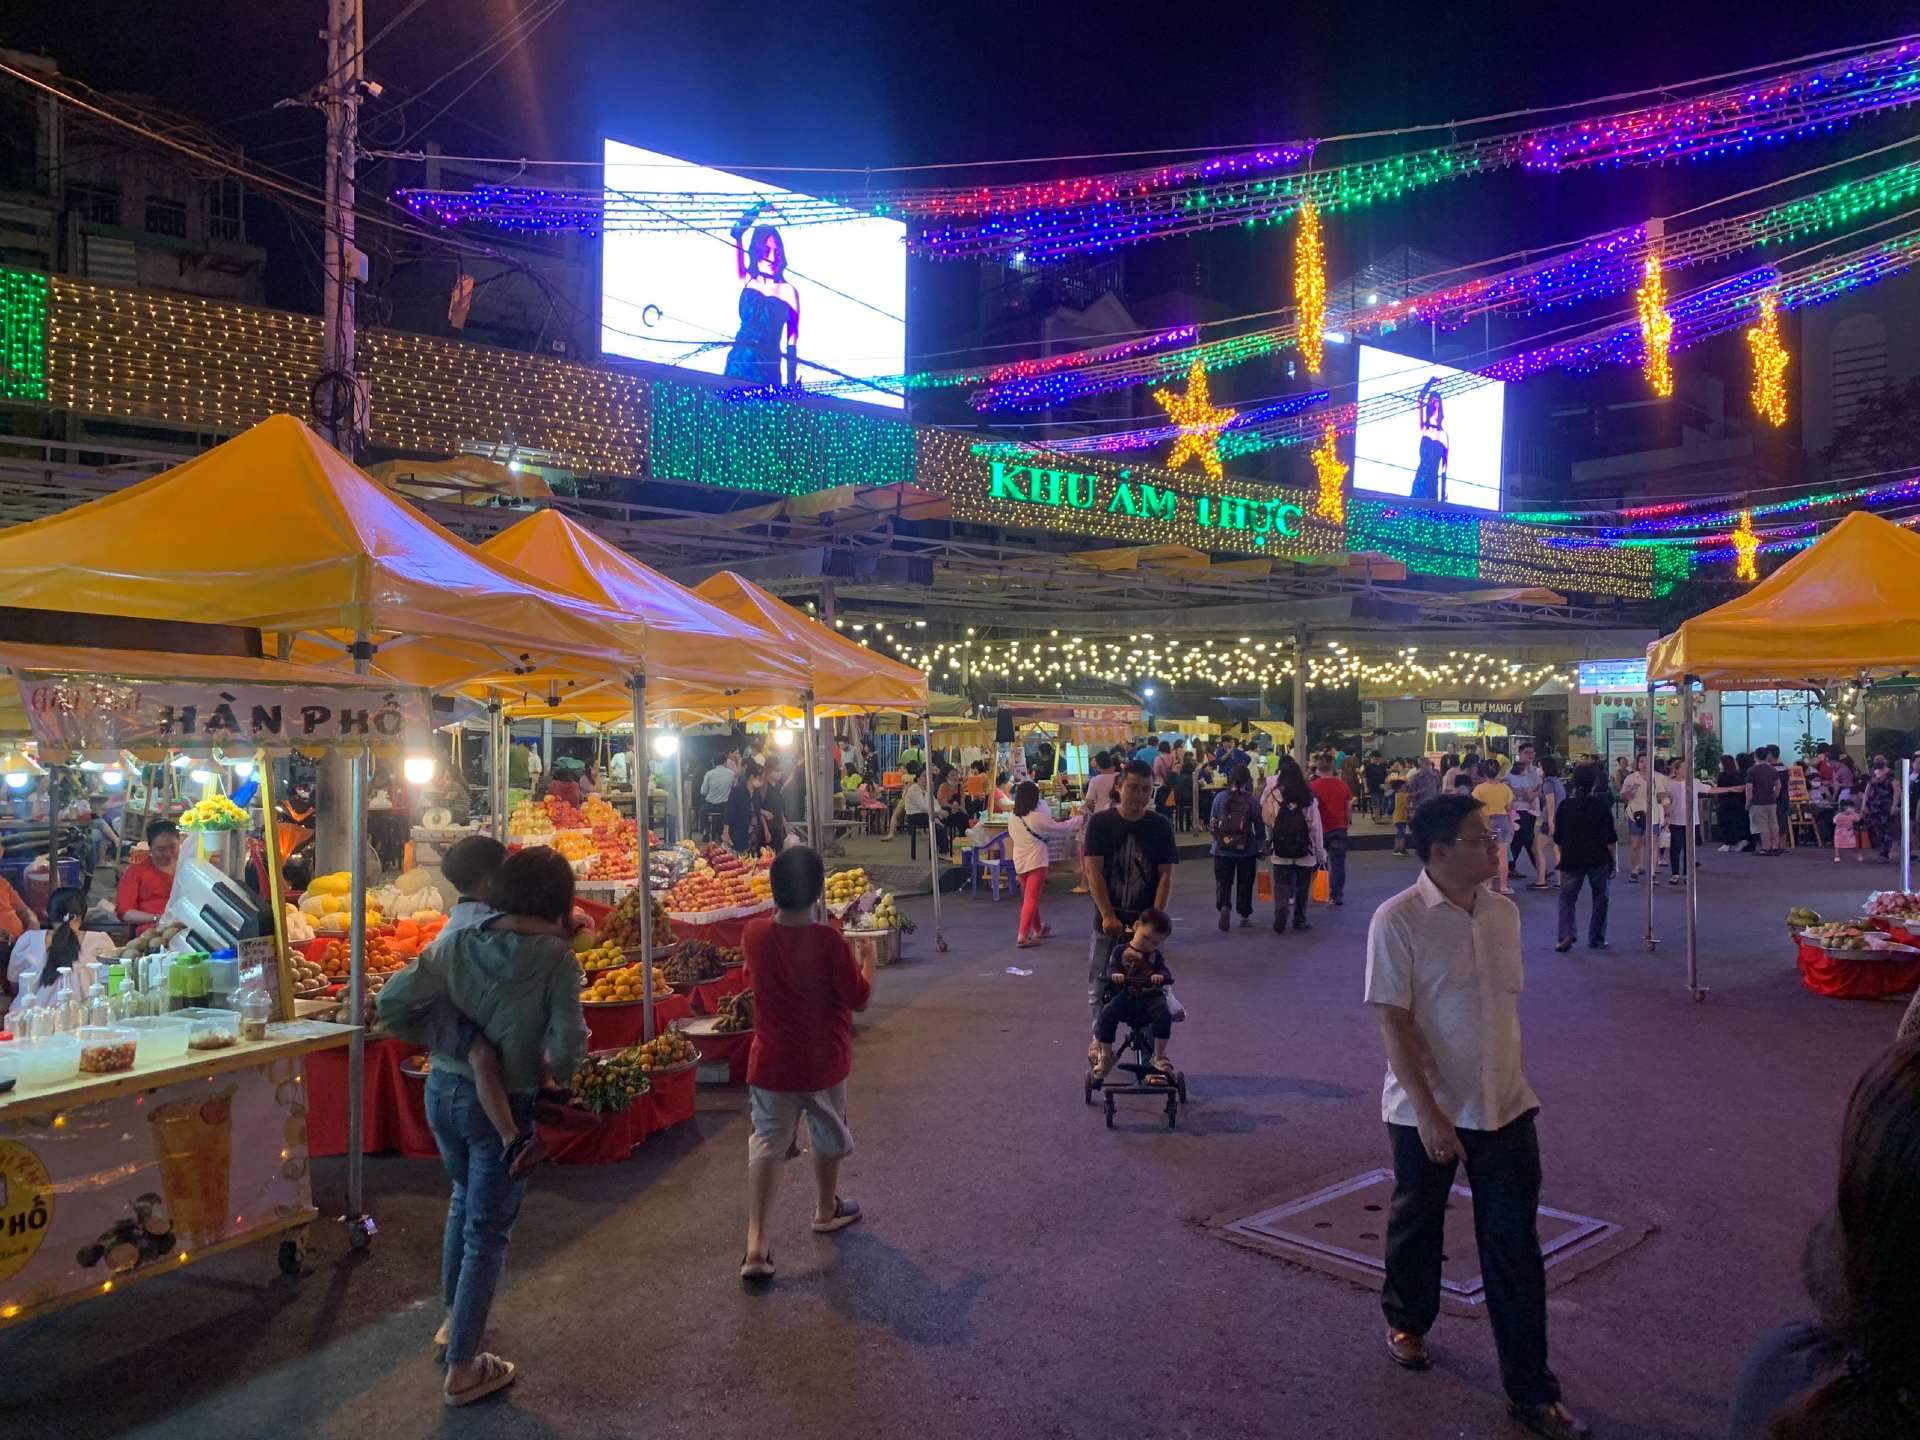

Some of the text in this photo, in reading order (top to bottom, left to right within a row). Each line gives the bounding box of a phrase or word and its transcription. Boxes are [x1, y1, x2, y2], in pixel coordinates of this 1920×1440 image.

[988, 461, 1099, 510] KHU
[159, 691, 283, 735] HÀN
[300, 692, 404, 735] PHỐ
